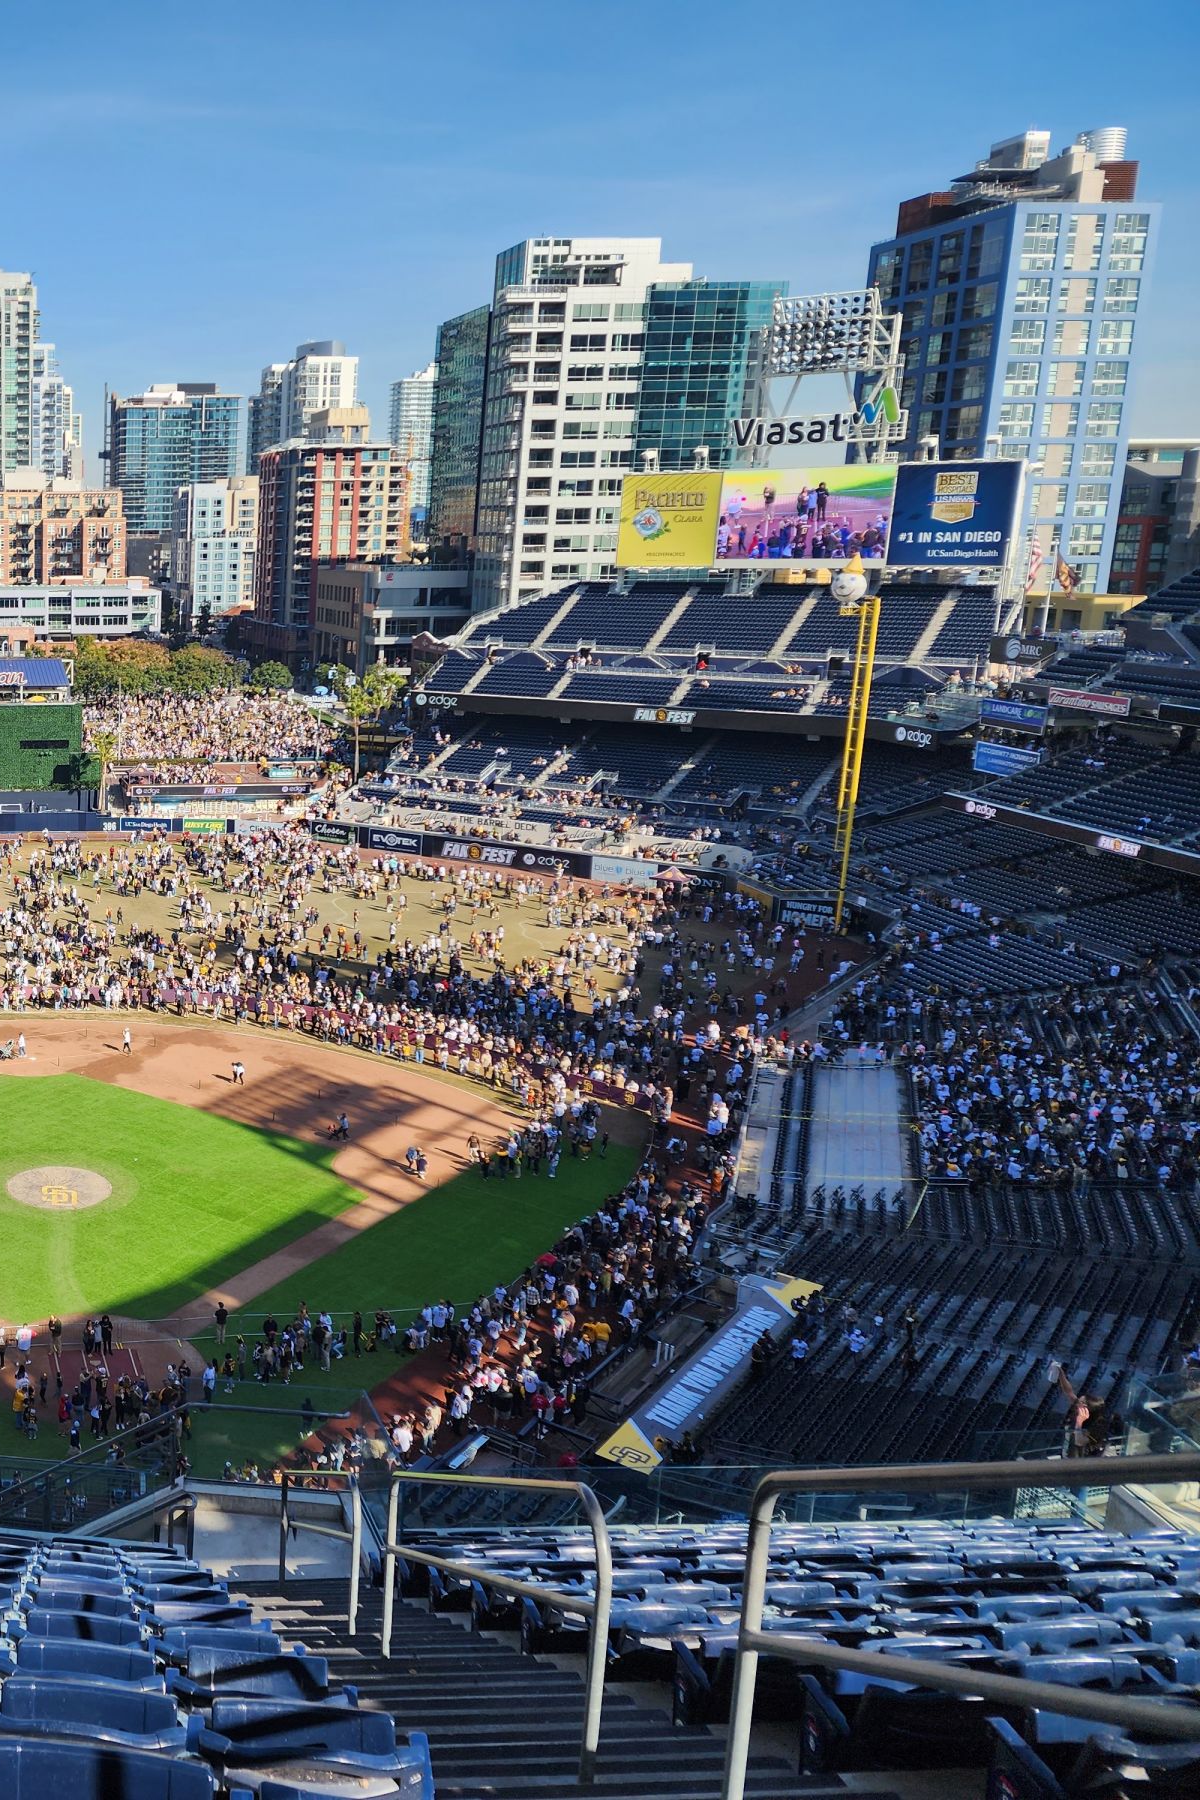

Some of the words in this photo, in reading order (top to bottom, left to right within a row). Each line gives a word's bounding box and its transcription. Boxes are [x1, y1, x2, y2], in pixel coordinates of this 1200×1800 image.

[733, 413, 849, 447] Viasat
[939, 474, 976, 486] BEST
[635, 489, 707, 510] PACIFICO
[673, 514, 704, 523] CLARA
[898, 532, 914, 543] #1
[918, 531, 932, 543] IN
[935, 531, 961, 543] SAN
[964, 531, 1002, 543] DIEGO
[1020, 644, 1043, 657] MRC
[428, 695, 458, 709] edge
[1050, 690, 1091, 710] Tarantino
[633, 708, 657, 722] FAN
[667, 711, 698, 725] FEST
[907, 729, 932, 748] edge
[975, 803, 997, 819] edge
[315, 823, 347, 837] Chosen
[459, 815, 476, 825] THE
[477, 817, 511, 829] BARREL
[514, 821, 538, 832] DECK
[372, 833, 419, 847] EVOTEK
[441, 840, 469, 860] FAN
[480, 845, 518, 866] FEST
[594, 863, 614, 872] blue
[626, 866, 646, 876] blue
[786, 901, 818, 911] HUNGRY
[818, 905, 834, 914] FOR
[680, 1363, 725, 1394] YOU
[644, 1383, 706, 1430] THANK
